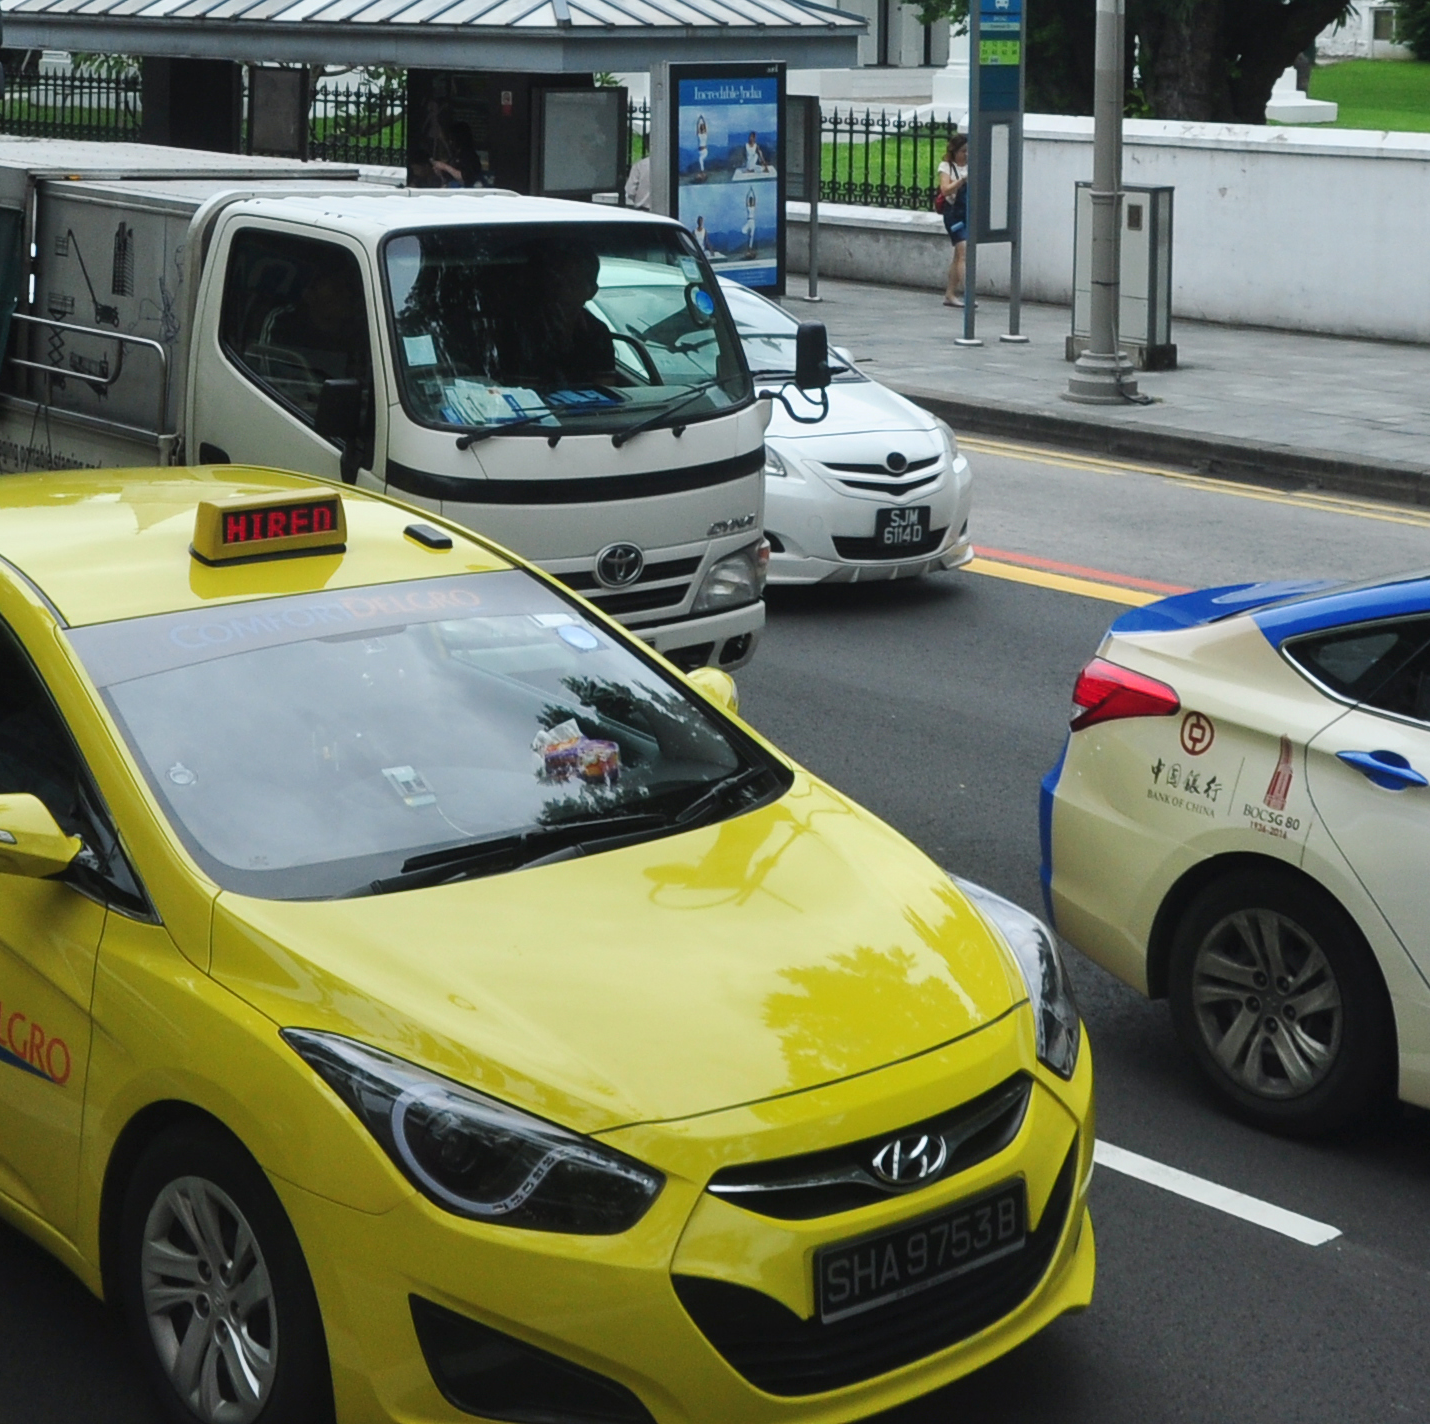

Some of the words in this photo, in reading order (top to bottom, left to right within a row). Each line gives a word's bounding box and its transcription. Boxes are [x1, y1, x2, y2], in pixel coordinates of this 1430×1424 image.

[694, 85, 740, 100] Incredible
[890, 508, 919, 526] SJM
[884, 525, 922, 544] 6114D
[1147, 789, 1171, 805] BANK
[1172, 795, 1183, 808] OF
[1185, 801, 1216, 818] CHINA
[1243, 804, 1283, 826] BOCSG
[1285, 816, 1300, 831] 80
